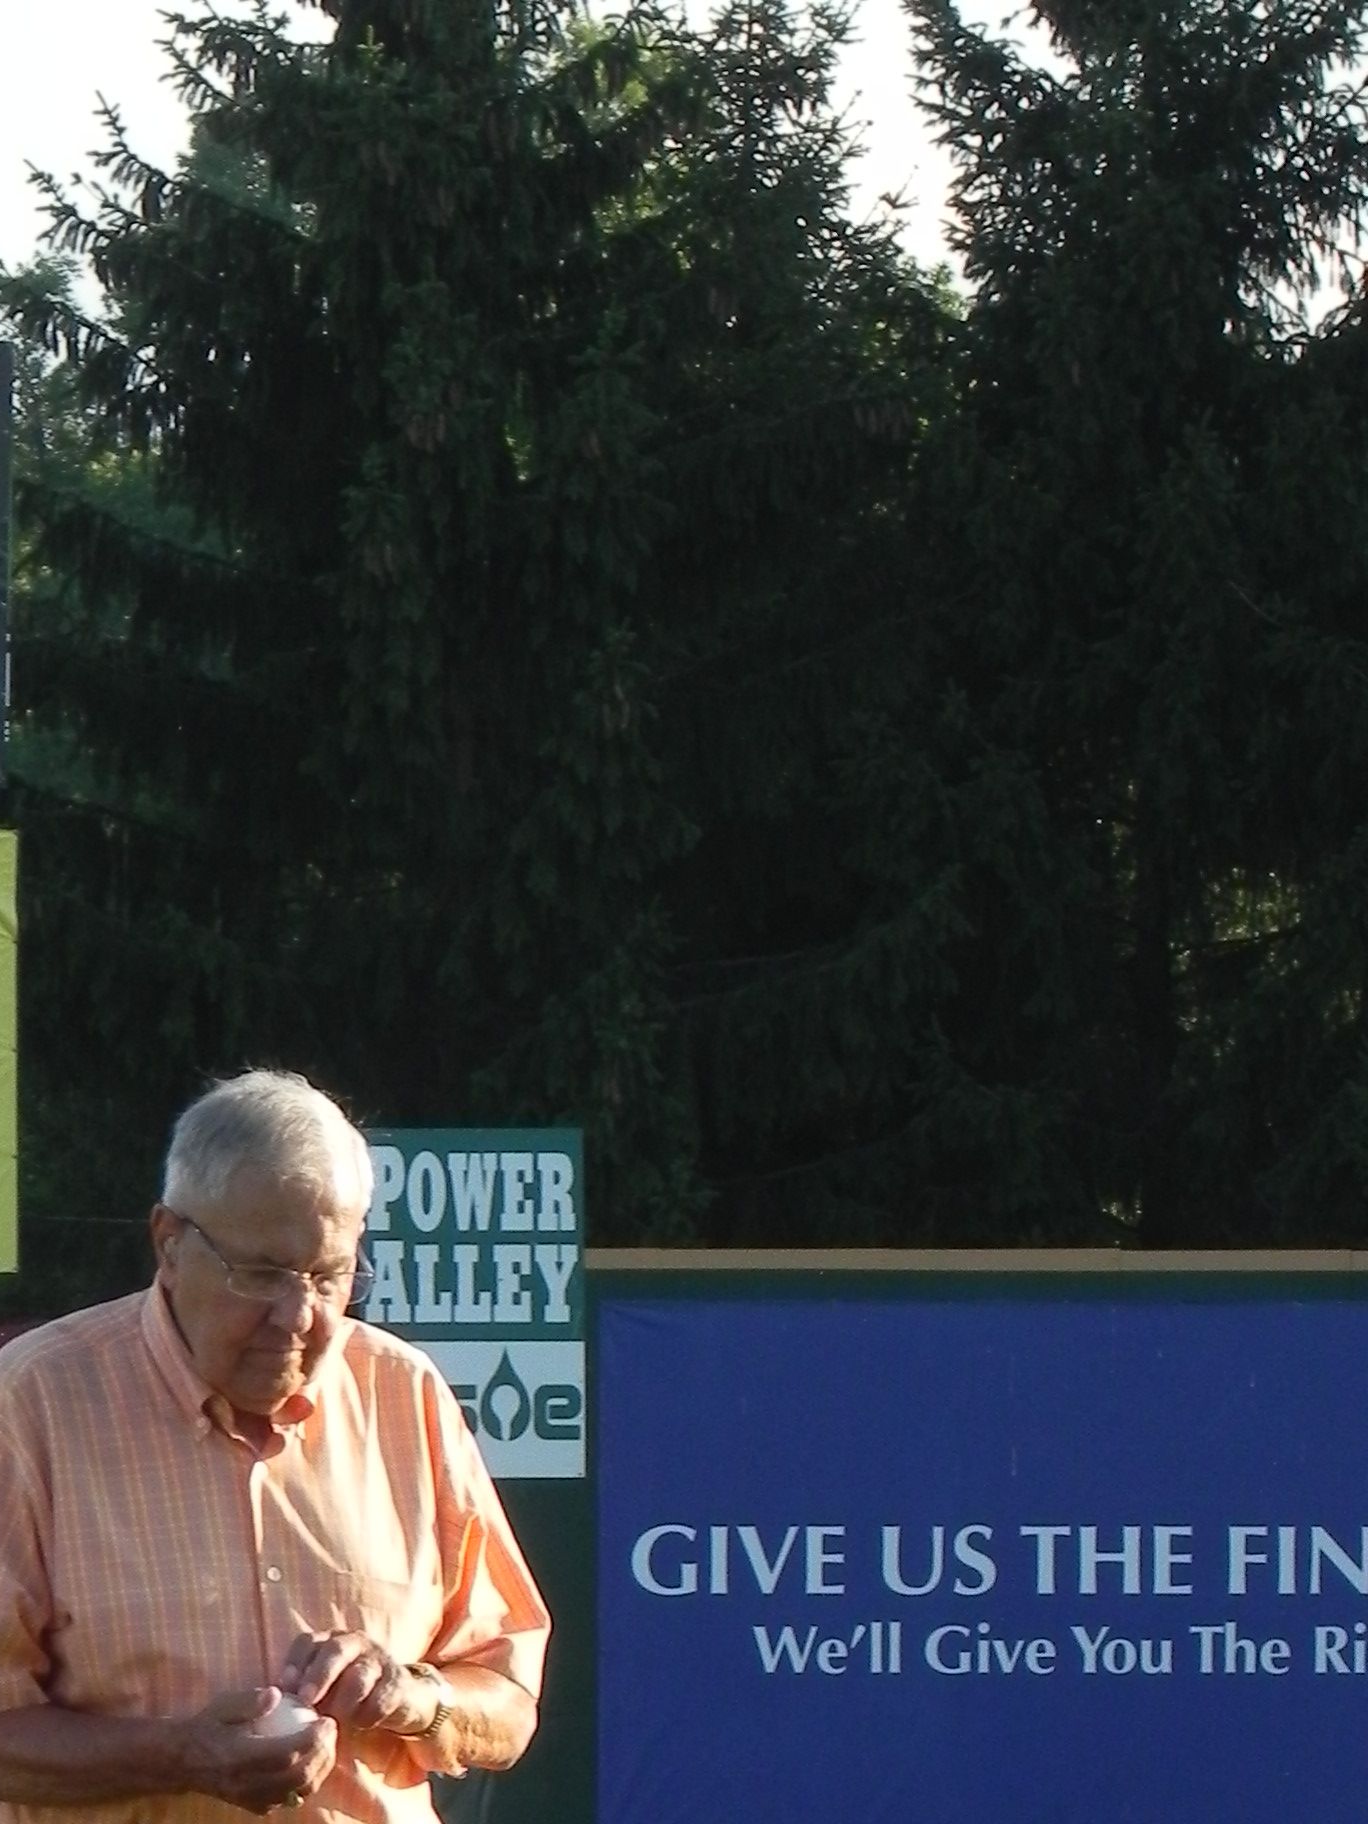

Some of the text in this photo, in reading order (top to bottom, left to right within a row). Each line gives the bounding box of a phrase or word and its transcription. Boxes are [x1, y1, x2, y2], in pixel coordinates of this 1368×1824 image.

[367, 1144, 577, 1233] POWER
[364, 1240, 578, 1323] ALLEY
[632, 1524, 1368, 1597] GIVE US THE FIN
[752, 1621, 1368, 1676] We'll Give You The Ri
